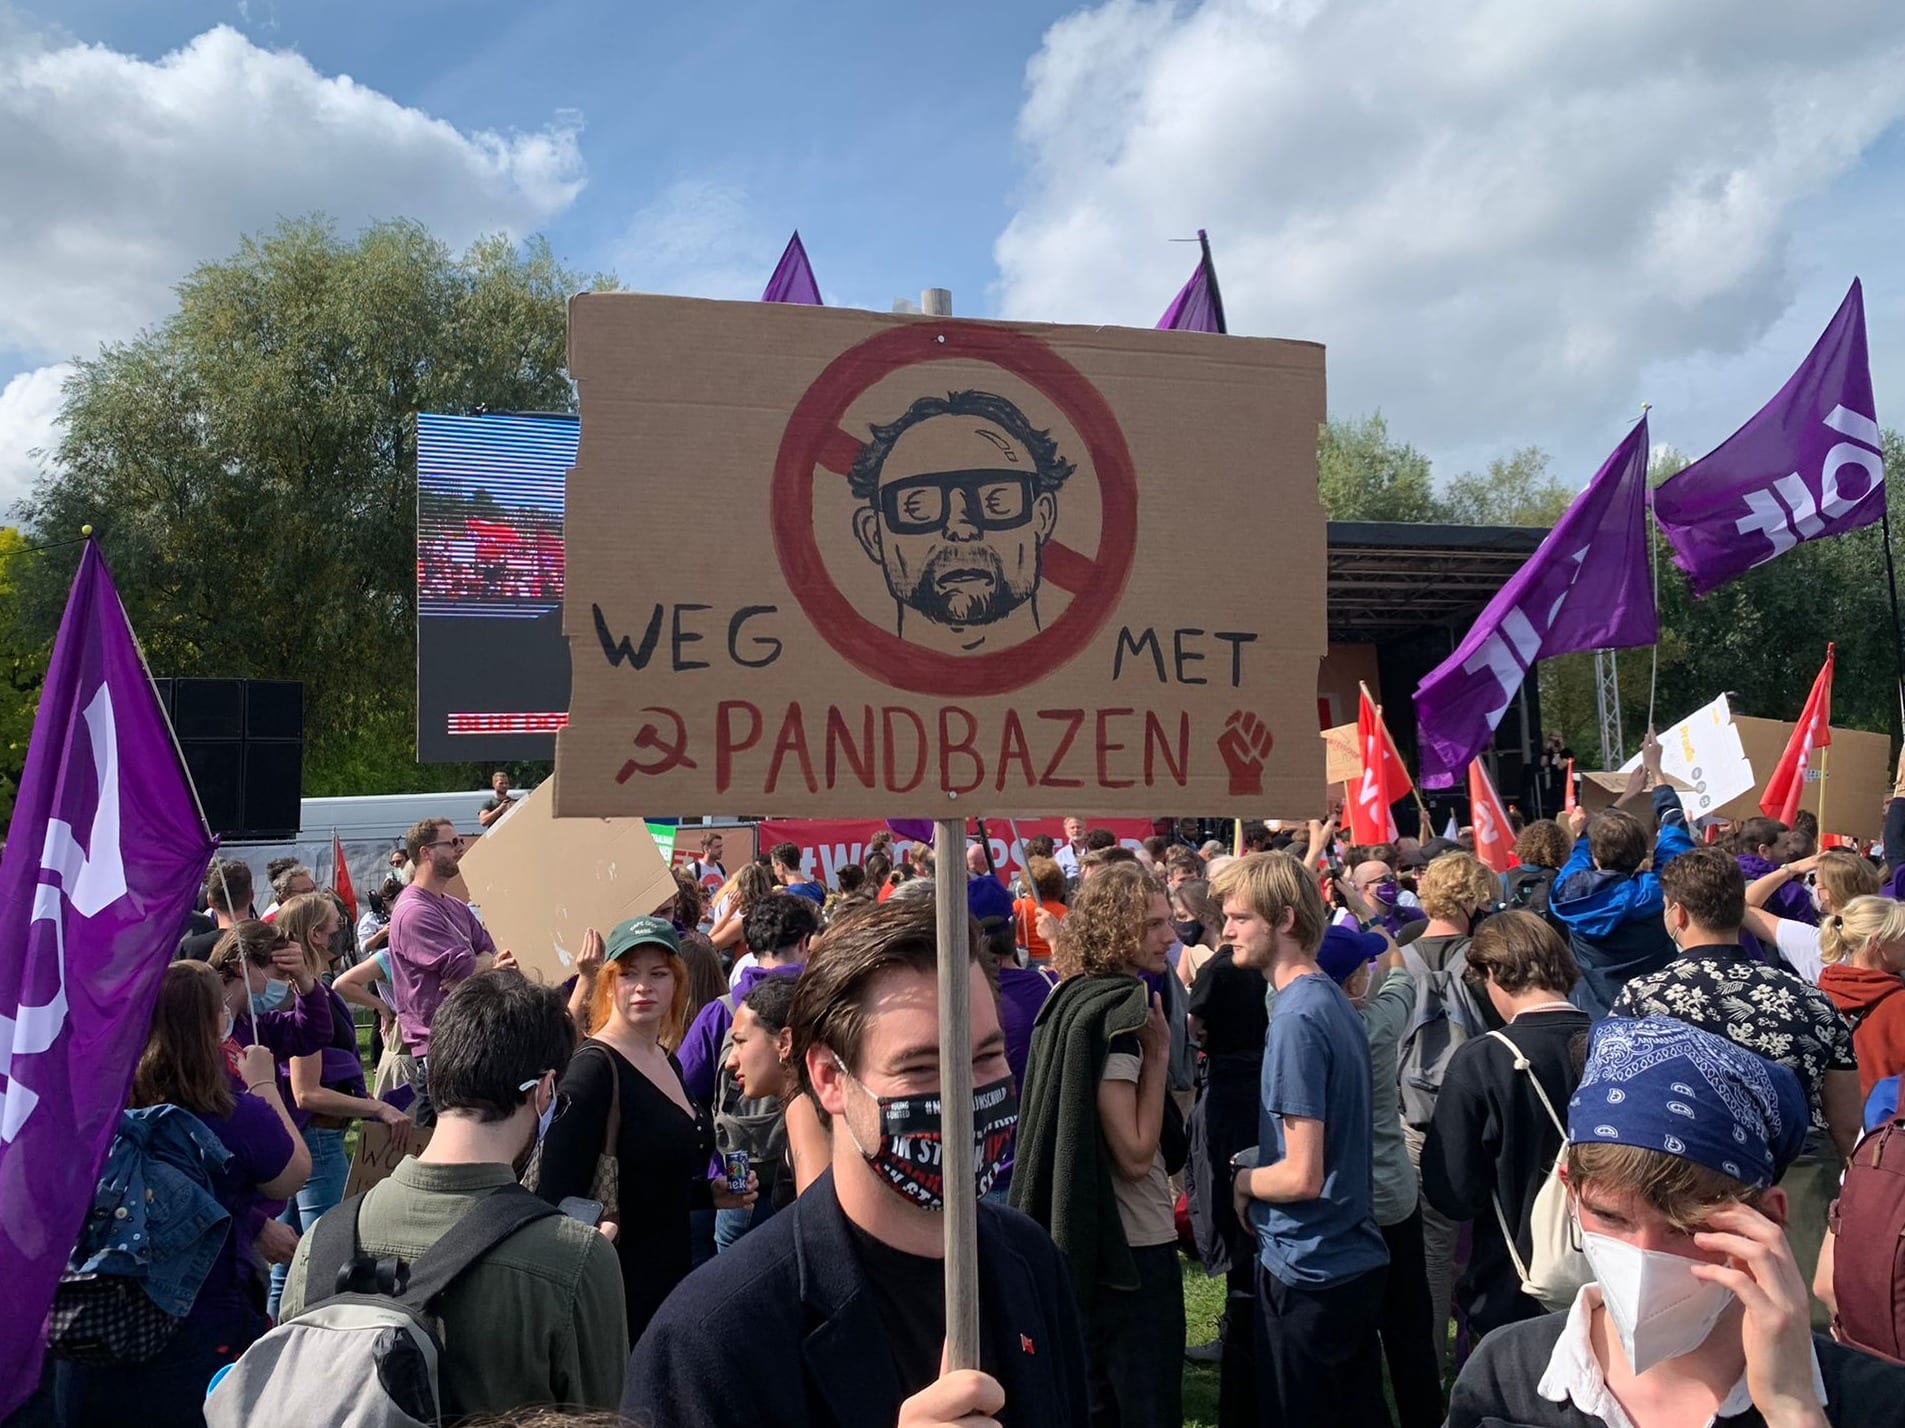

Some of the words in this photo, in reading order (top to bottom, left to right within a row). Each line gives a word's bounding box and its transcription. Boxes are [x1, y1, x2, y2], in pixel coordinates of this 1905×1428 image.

[593, 602, 783, 672] WEG
[1112, 626, 1258, 688] MET
[716, 699, 1189, 795] PANDBAZEN
